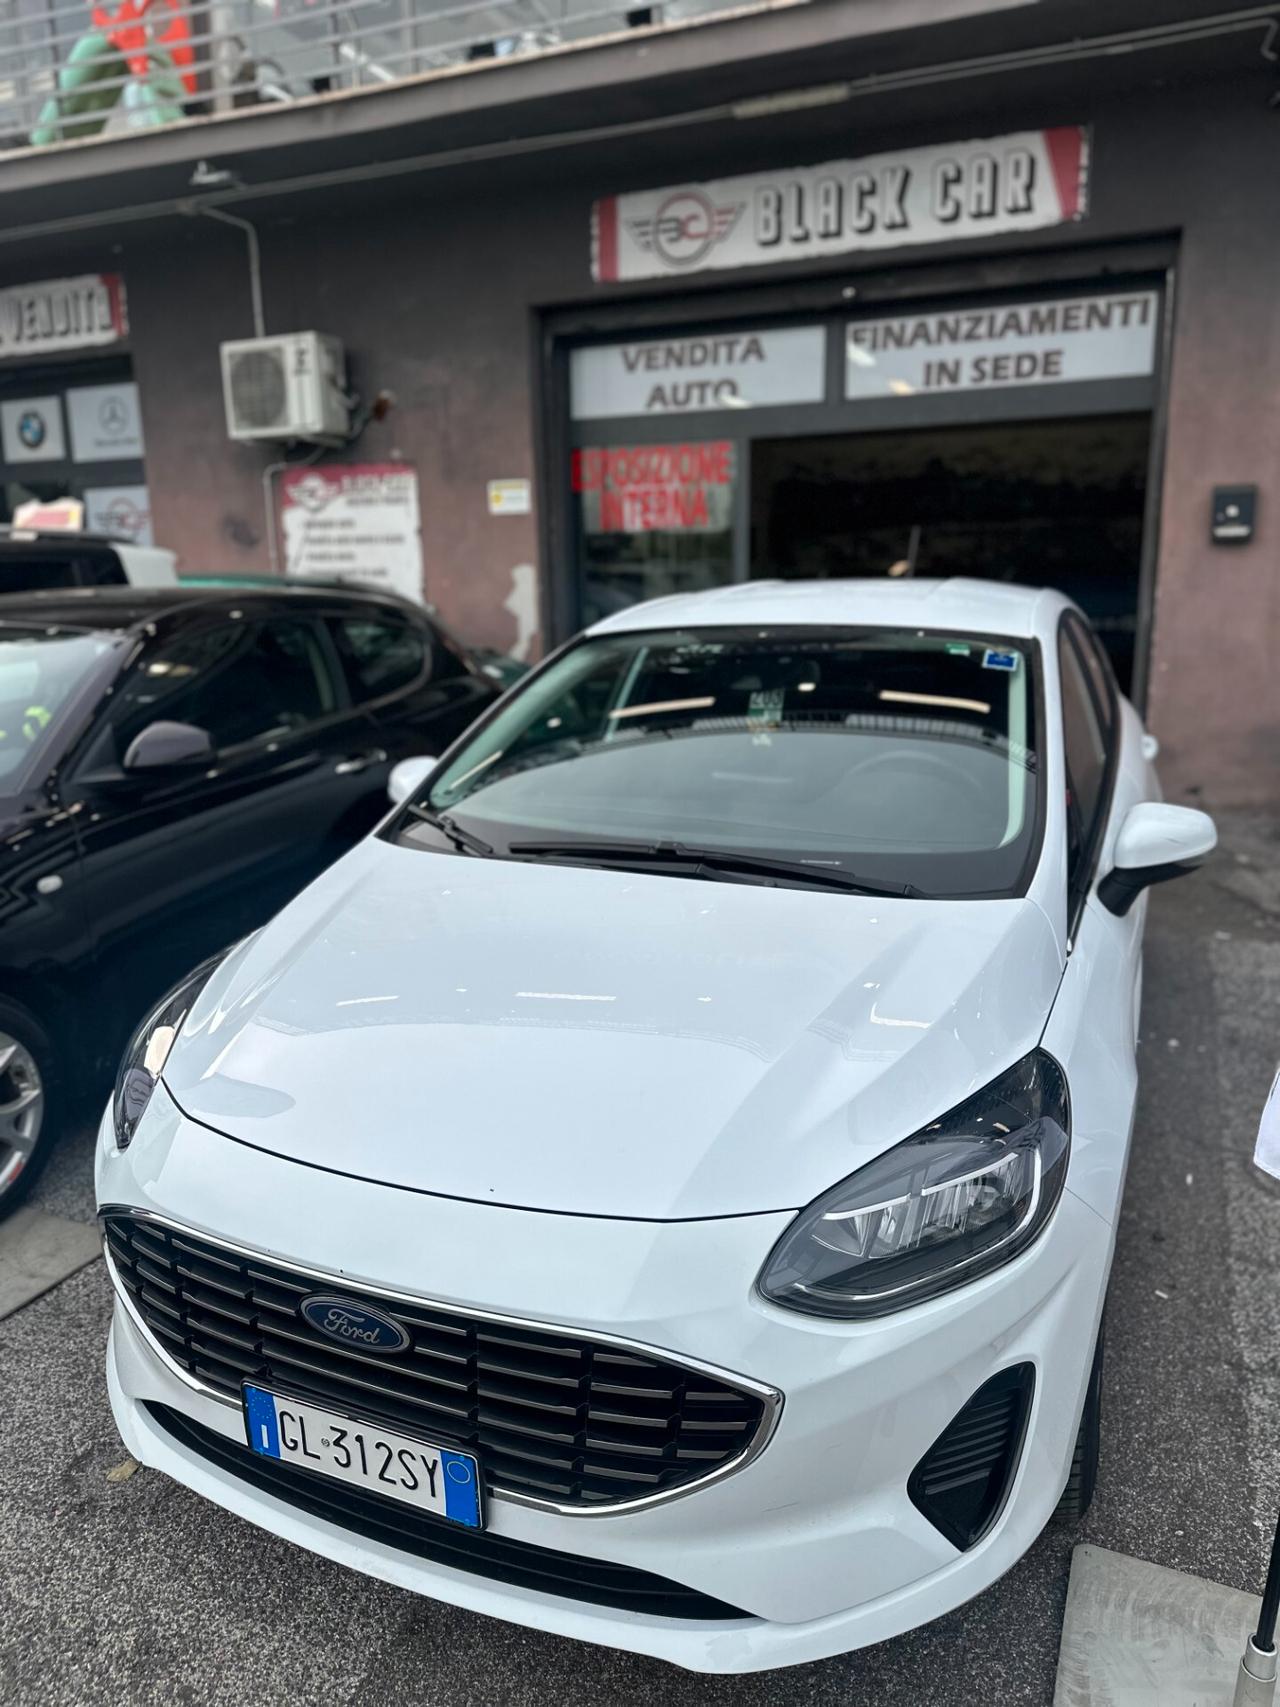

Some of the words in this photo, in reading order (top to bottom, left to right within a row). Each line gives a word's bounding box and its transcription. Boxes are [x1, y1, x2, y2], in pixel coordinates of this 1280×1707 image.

[754, 165, 912, 247] BLACK
[930, 146, 1036, 223] CAR
[850, 297, 1151, 352] FINANZIAMENTI
[621, 334, 766, 374] VENDITA
[924, 359, 961, 388] IN
[970, 348, 1064, 385] SEDE
[646, 378, 740, 410] AUTO
[571, 439, 733, 492] ESPOSIZIONE
[598, 486, 709, 532] INTERNA
[323, 1308, 381, 1344] Ford
